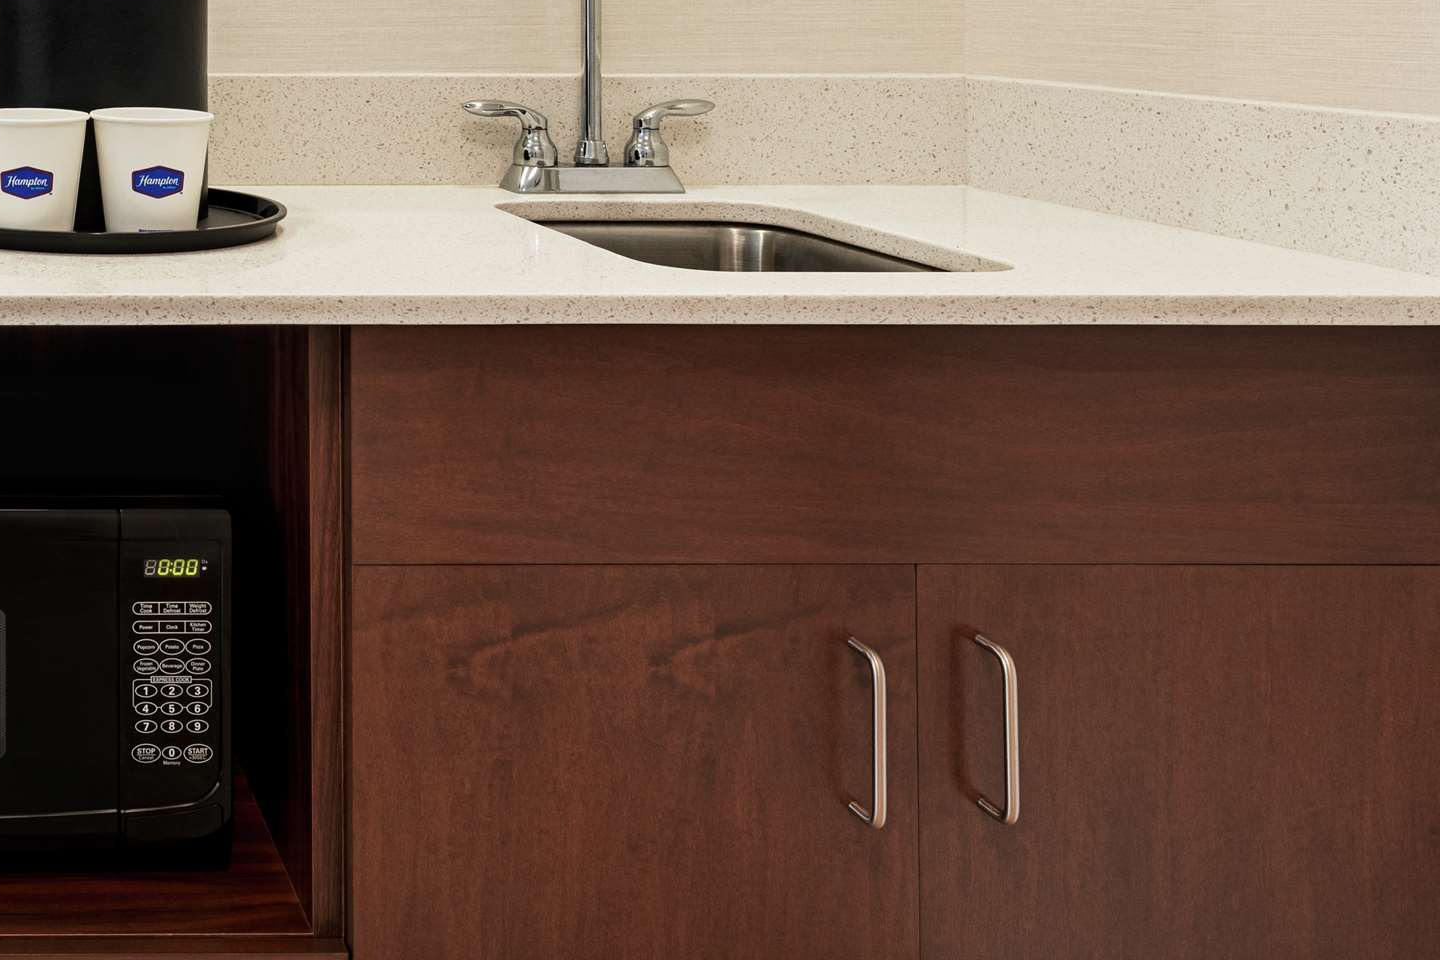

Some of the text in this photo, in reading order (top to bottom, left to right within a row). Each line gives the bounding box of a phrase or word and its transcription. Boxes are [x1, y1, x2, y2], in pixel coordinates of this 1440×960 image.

[4, 175, 48, 187] Hampton
[136, 175, 179, 187] Hampton
[143, 686, 149, 695] 1
[168, 686, 175, 695] 2
[194, 686, 201, 695] 3
[142, 704, 150, 713] 4
[168, 704, 175, 713] 5
[194, 704, 201, 713] 6
[143, 722, 150, 731] 7
[168, 722, 175, 731] 8
[194, 722, 201, 731] 9
[168, 748, 175, 757] 0
